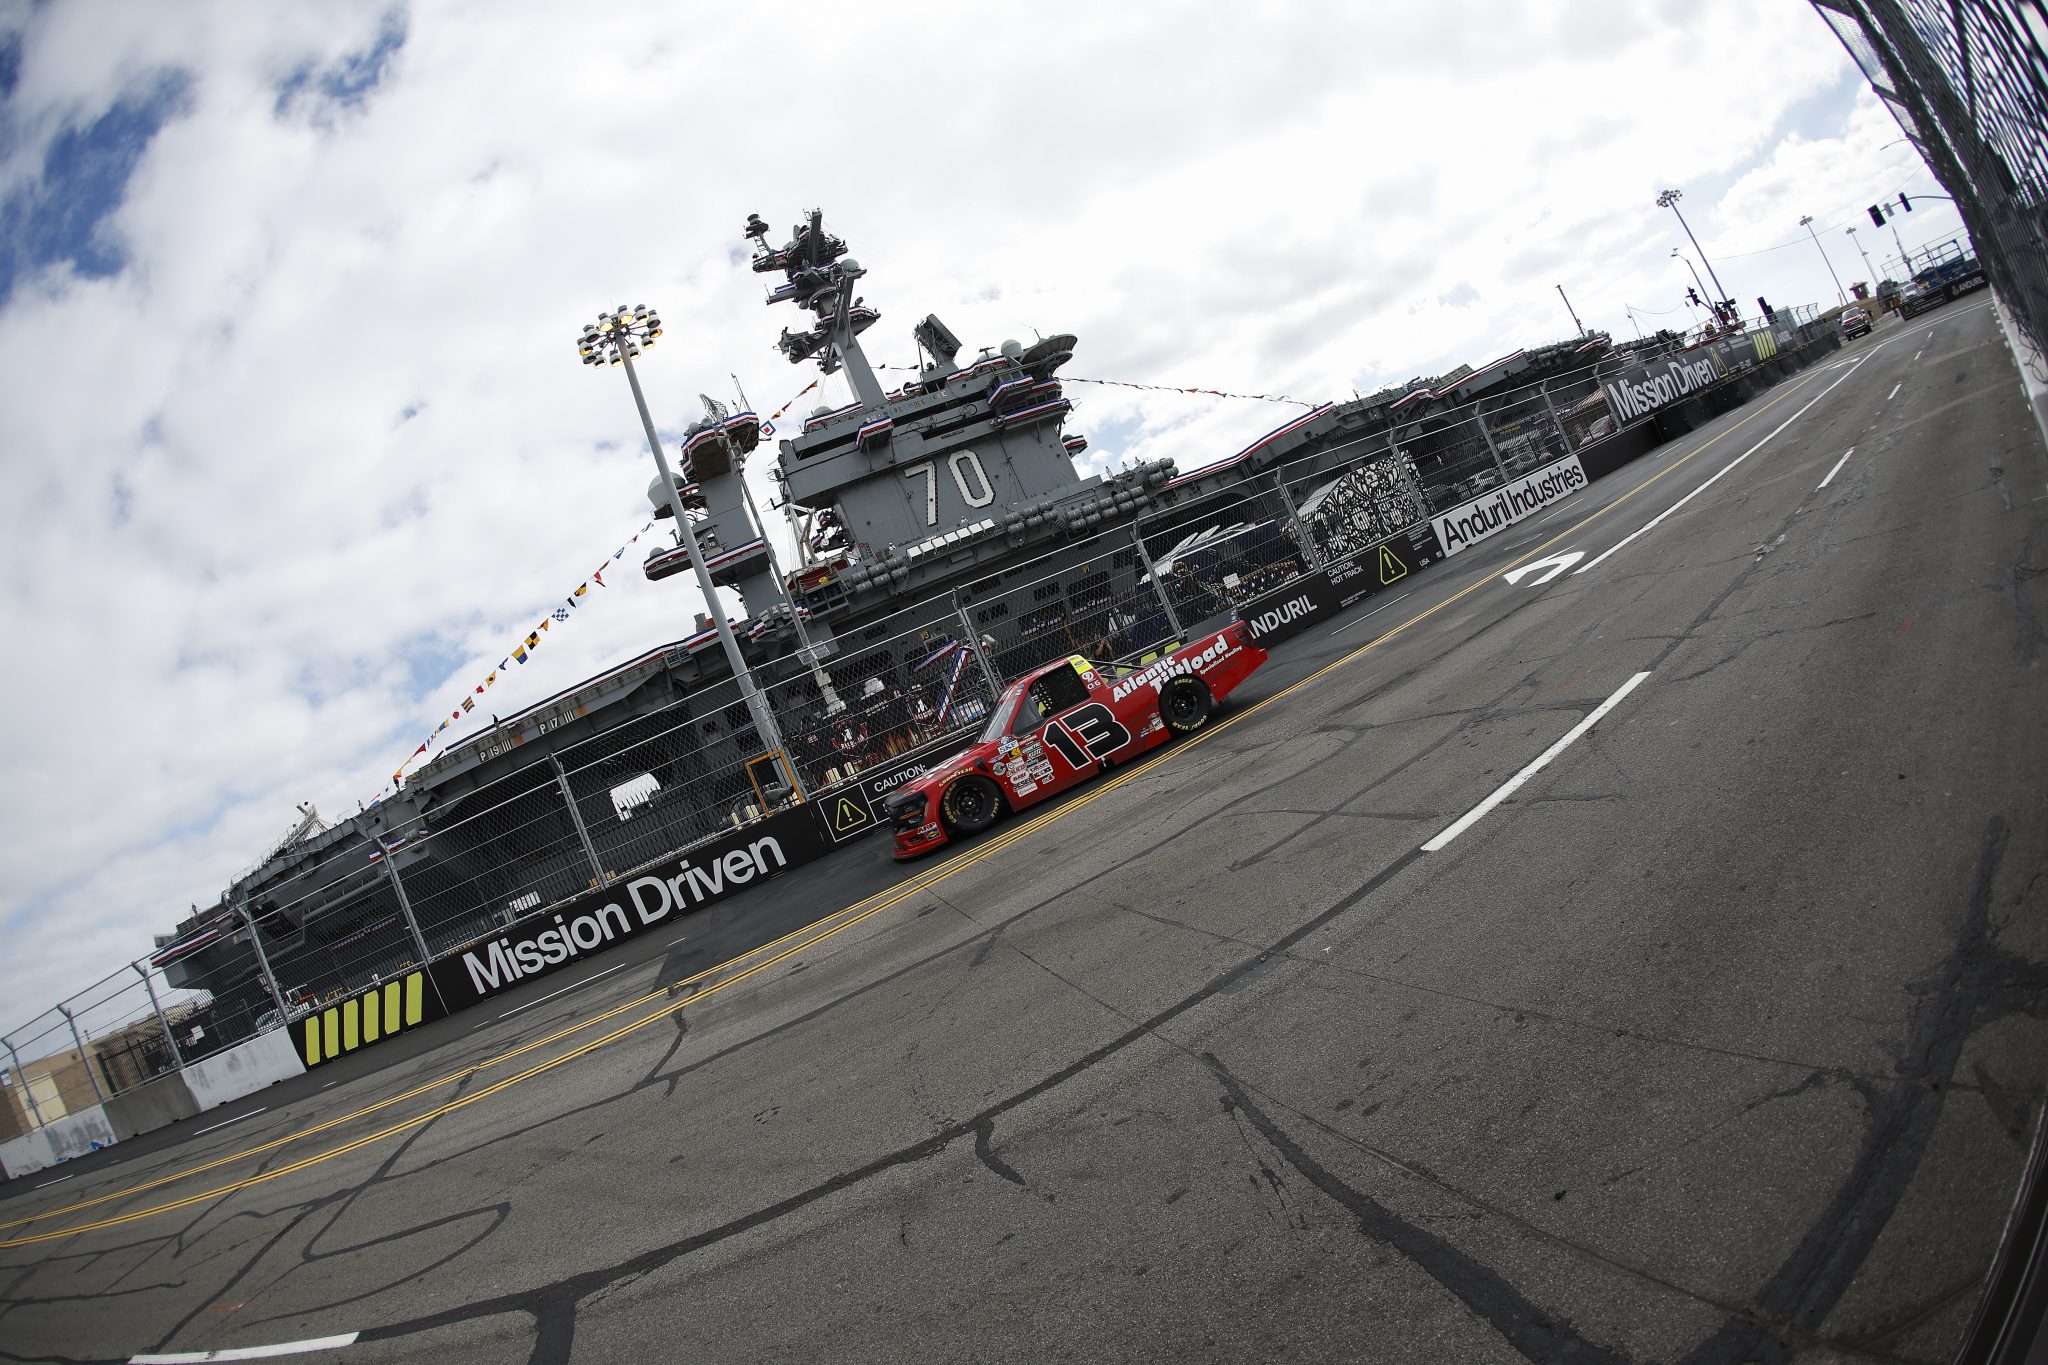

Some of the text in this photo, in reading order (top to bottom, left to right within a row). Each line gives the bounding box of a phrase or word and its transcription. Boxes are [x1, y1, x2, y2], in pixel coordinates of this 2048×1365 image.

[1958, 276, 1985, 292] ANDURIL
[1607, 371, 1679, 421] Mission
[1667, 358, 1718, 395] Driven
[904, 449, 996, 526] 70
[1442, 464, 1584, 551] Anduril Industries
[1327, 561, 1355, 578] CAUTION:
[1418, 557, 1431, 567] USA
[1330, 566, 1364, 586] HOT TRACK
[1112, 656, 1176, 703] Atlantic
[1174, 678, 1193, 686] EAGLE
[549, 717, 558, 729] 17
[1000, 740, 1016, 752] SKF
[1043, 702, 1132, 770] 13
[489, 745, 500, 757] 19
[874, 762, 927, 792] CAUTION:
[462, 836, 787, 995] Mission Driven
